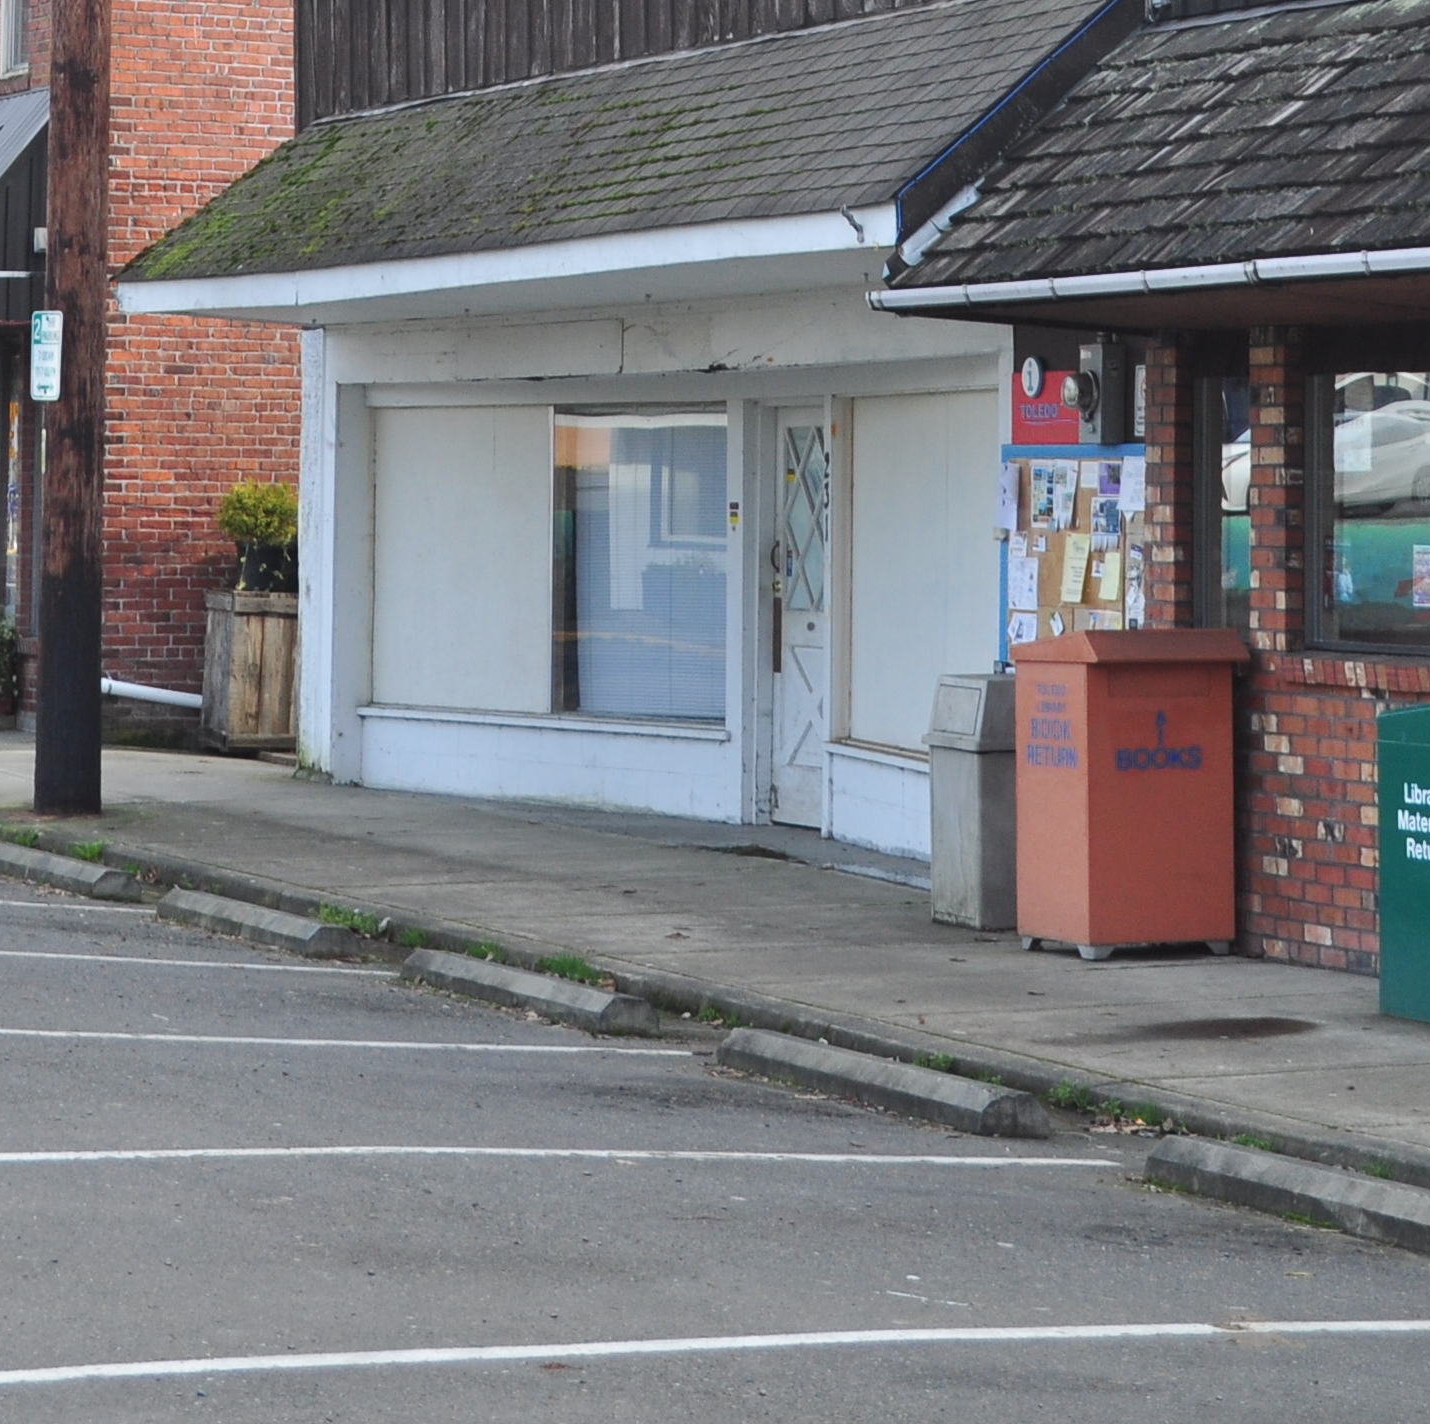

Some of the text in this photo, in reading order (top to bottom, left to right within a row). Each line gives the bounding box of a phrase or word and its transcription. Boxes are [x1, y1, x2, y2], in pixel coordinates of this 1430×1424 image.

[34, 318, 41, 340] 2
[1019, 402, 1059, 419] TOLEDO
[1030, 716, 1072, 741] BOOK
[1026, 743, 1078, 769] RETURN
[1115, 744, 1203, 772] BOOKS
